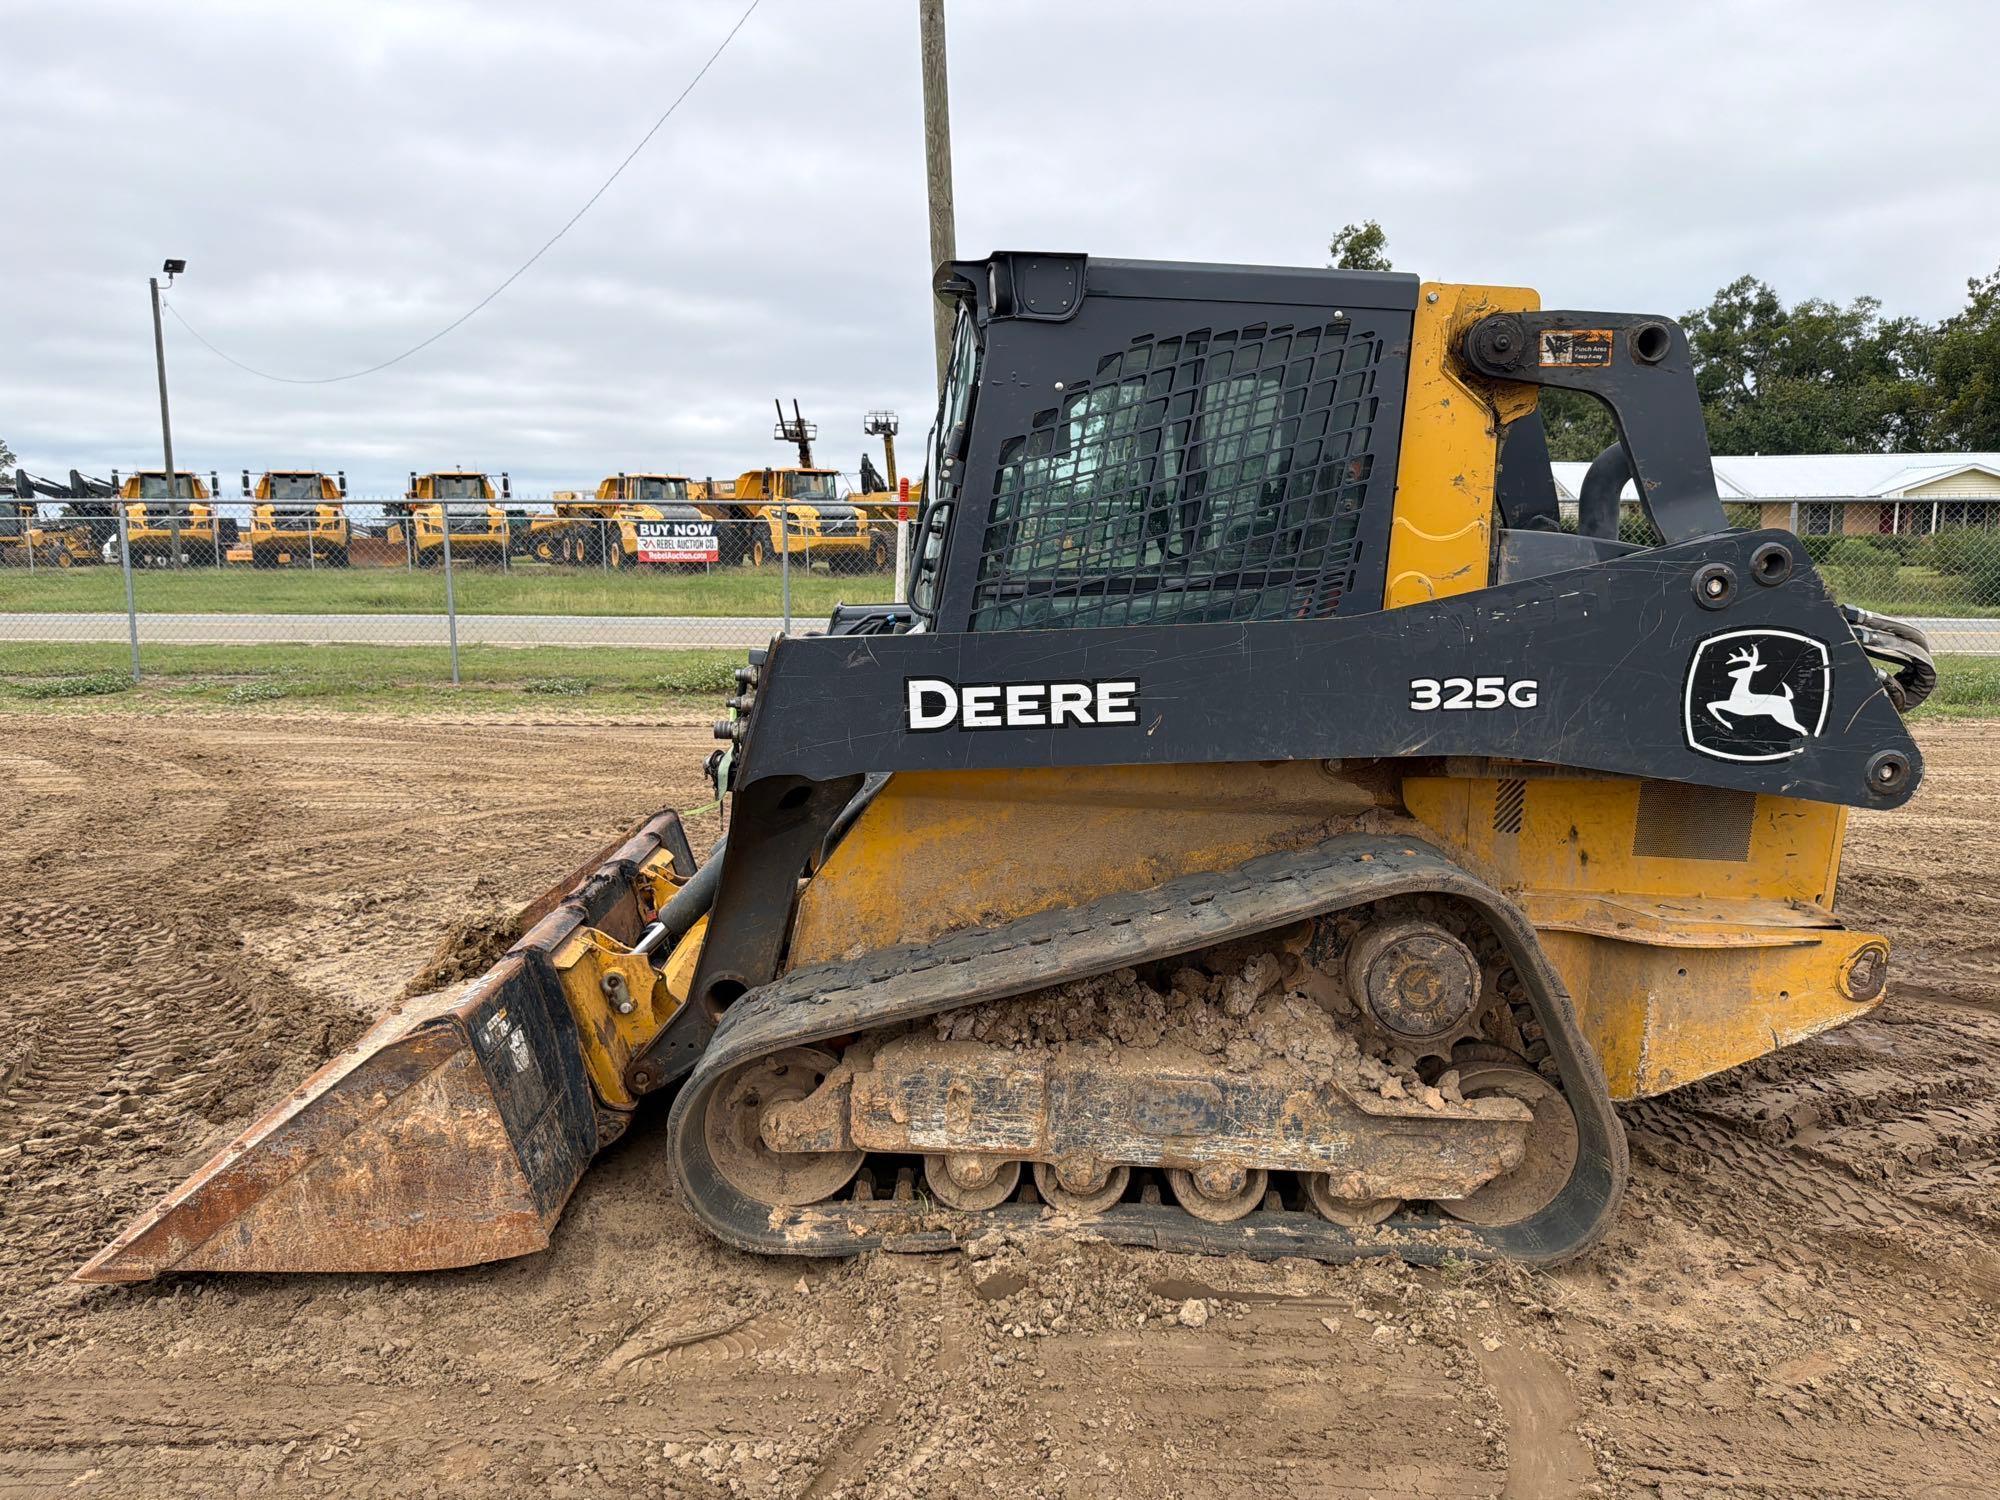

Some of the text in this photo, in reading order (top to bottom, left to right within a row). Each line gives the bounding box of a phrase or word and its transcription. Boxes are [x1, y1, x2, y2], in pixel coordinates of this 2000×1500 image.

[639, 523, 713, 536] BUY NOW
[656, 539, 676, 549] REBEL
[677, 539, 704, 549] AUCTION
[648, 551, 708, 560] RebelAuction.com
[1410, 676, 1538, 711] 325G
[908, 679, 1137, 729] DEERE
